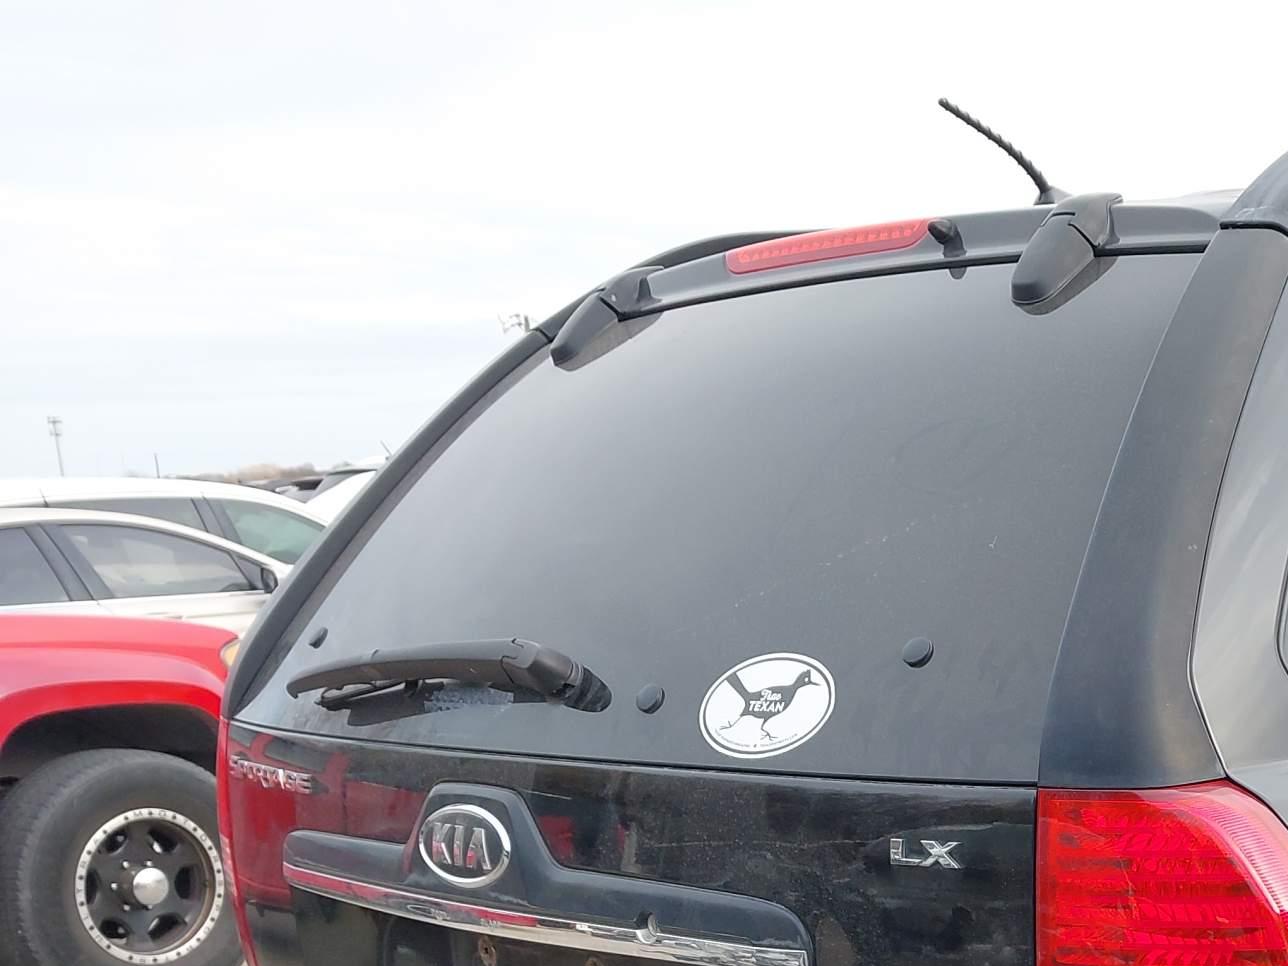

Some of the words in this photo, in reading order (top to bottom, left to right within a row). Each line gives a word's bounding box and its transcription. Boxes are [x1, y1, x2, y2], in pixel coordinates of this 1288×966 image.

[748, 700, 785, 713] TEXAN
[430, 821, 493, 871] KIA
[889, 838, 963, 870] LX
